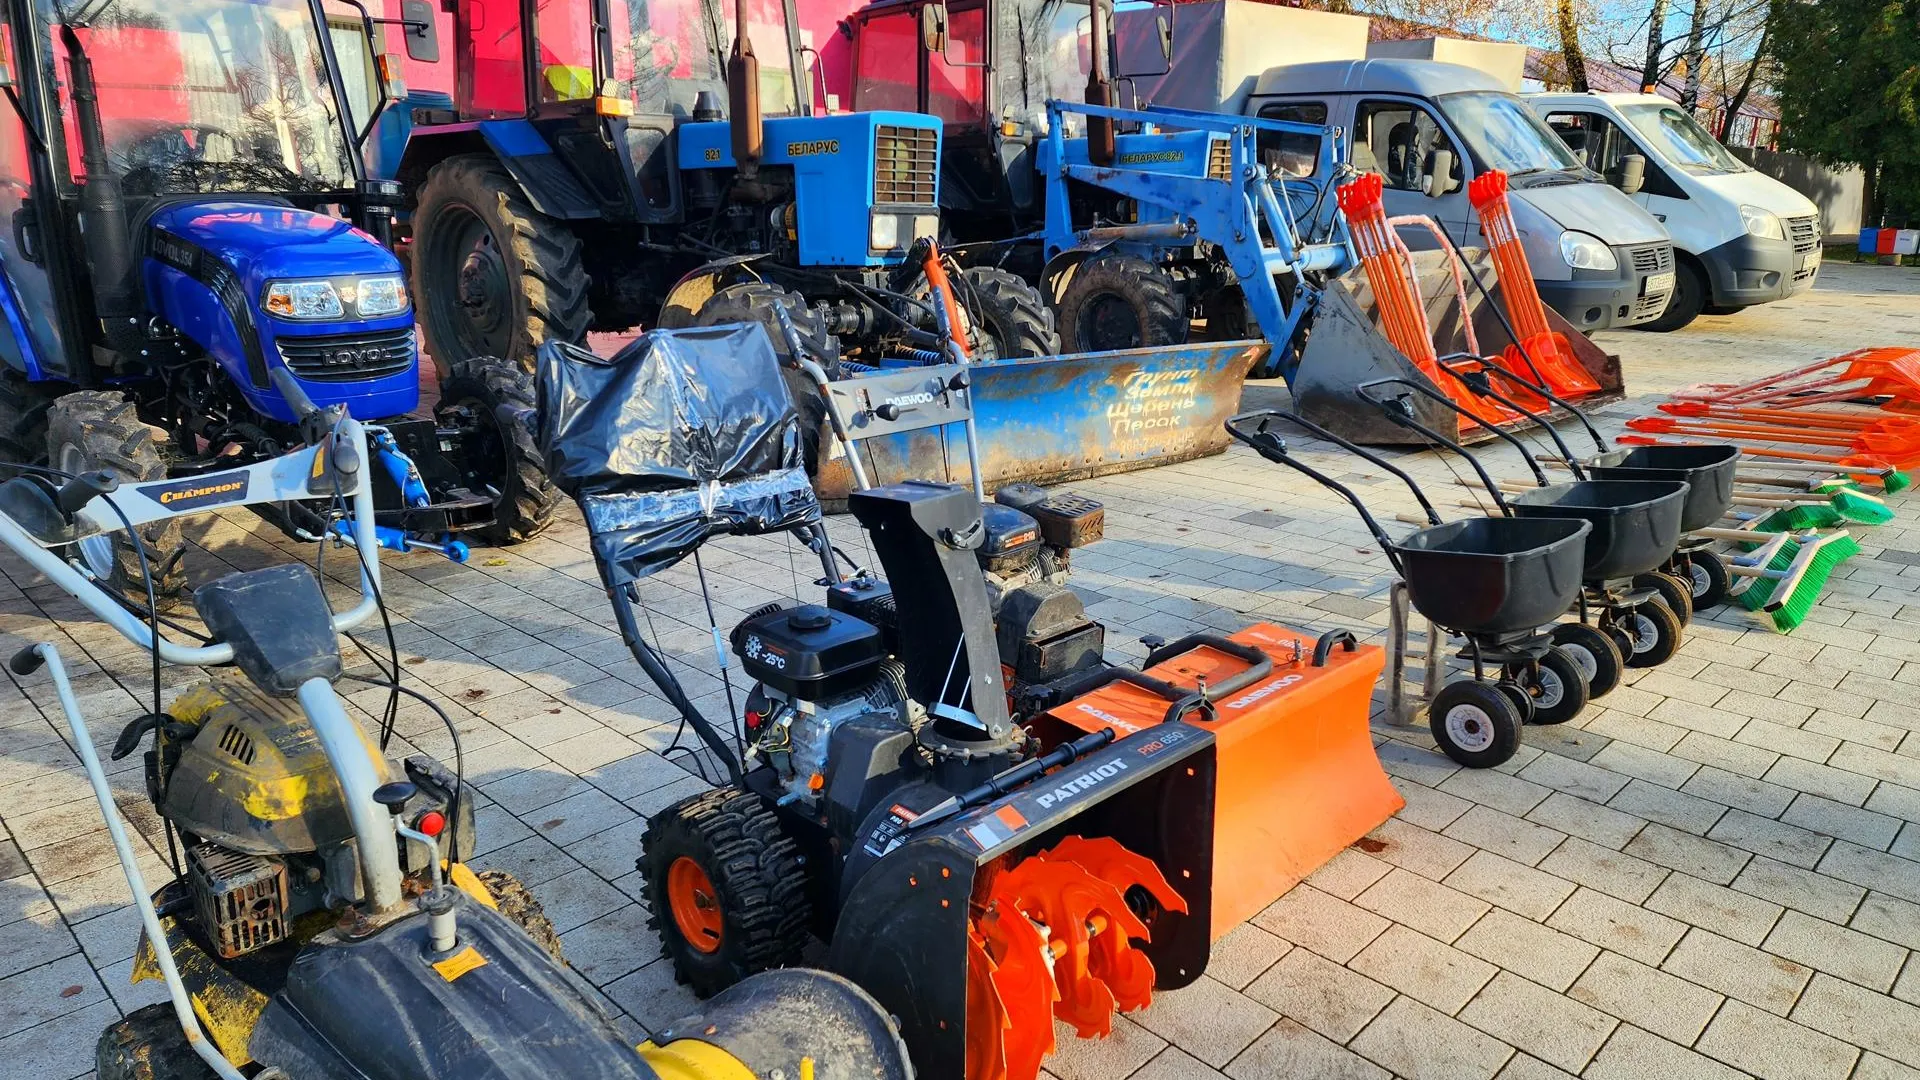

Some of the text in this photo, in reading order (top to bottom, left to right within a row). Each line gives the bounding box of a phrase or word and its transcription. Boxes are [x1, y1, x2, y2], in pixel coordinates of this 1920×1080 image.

[787, 140, 839, 157] БЕЛАРУС
[1121, 152, 1166, 164] БЕЛАРУС
[323, 348, 392, 366] LOVOL
[1123, 369, 1198, 390] Грунт
[885, 392, 934, 406] DAEWOO
[1113, 416, 1181, 435] Песок
[1225, 674, 1303, 708] DAEWOO
[1076, 703, 1143, 733] DAEWO
[1136, 731, 1185, 756] PRO 650
[1036, 757, 1128, 809] PATRIOT
